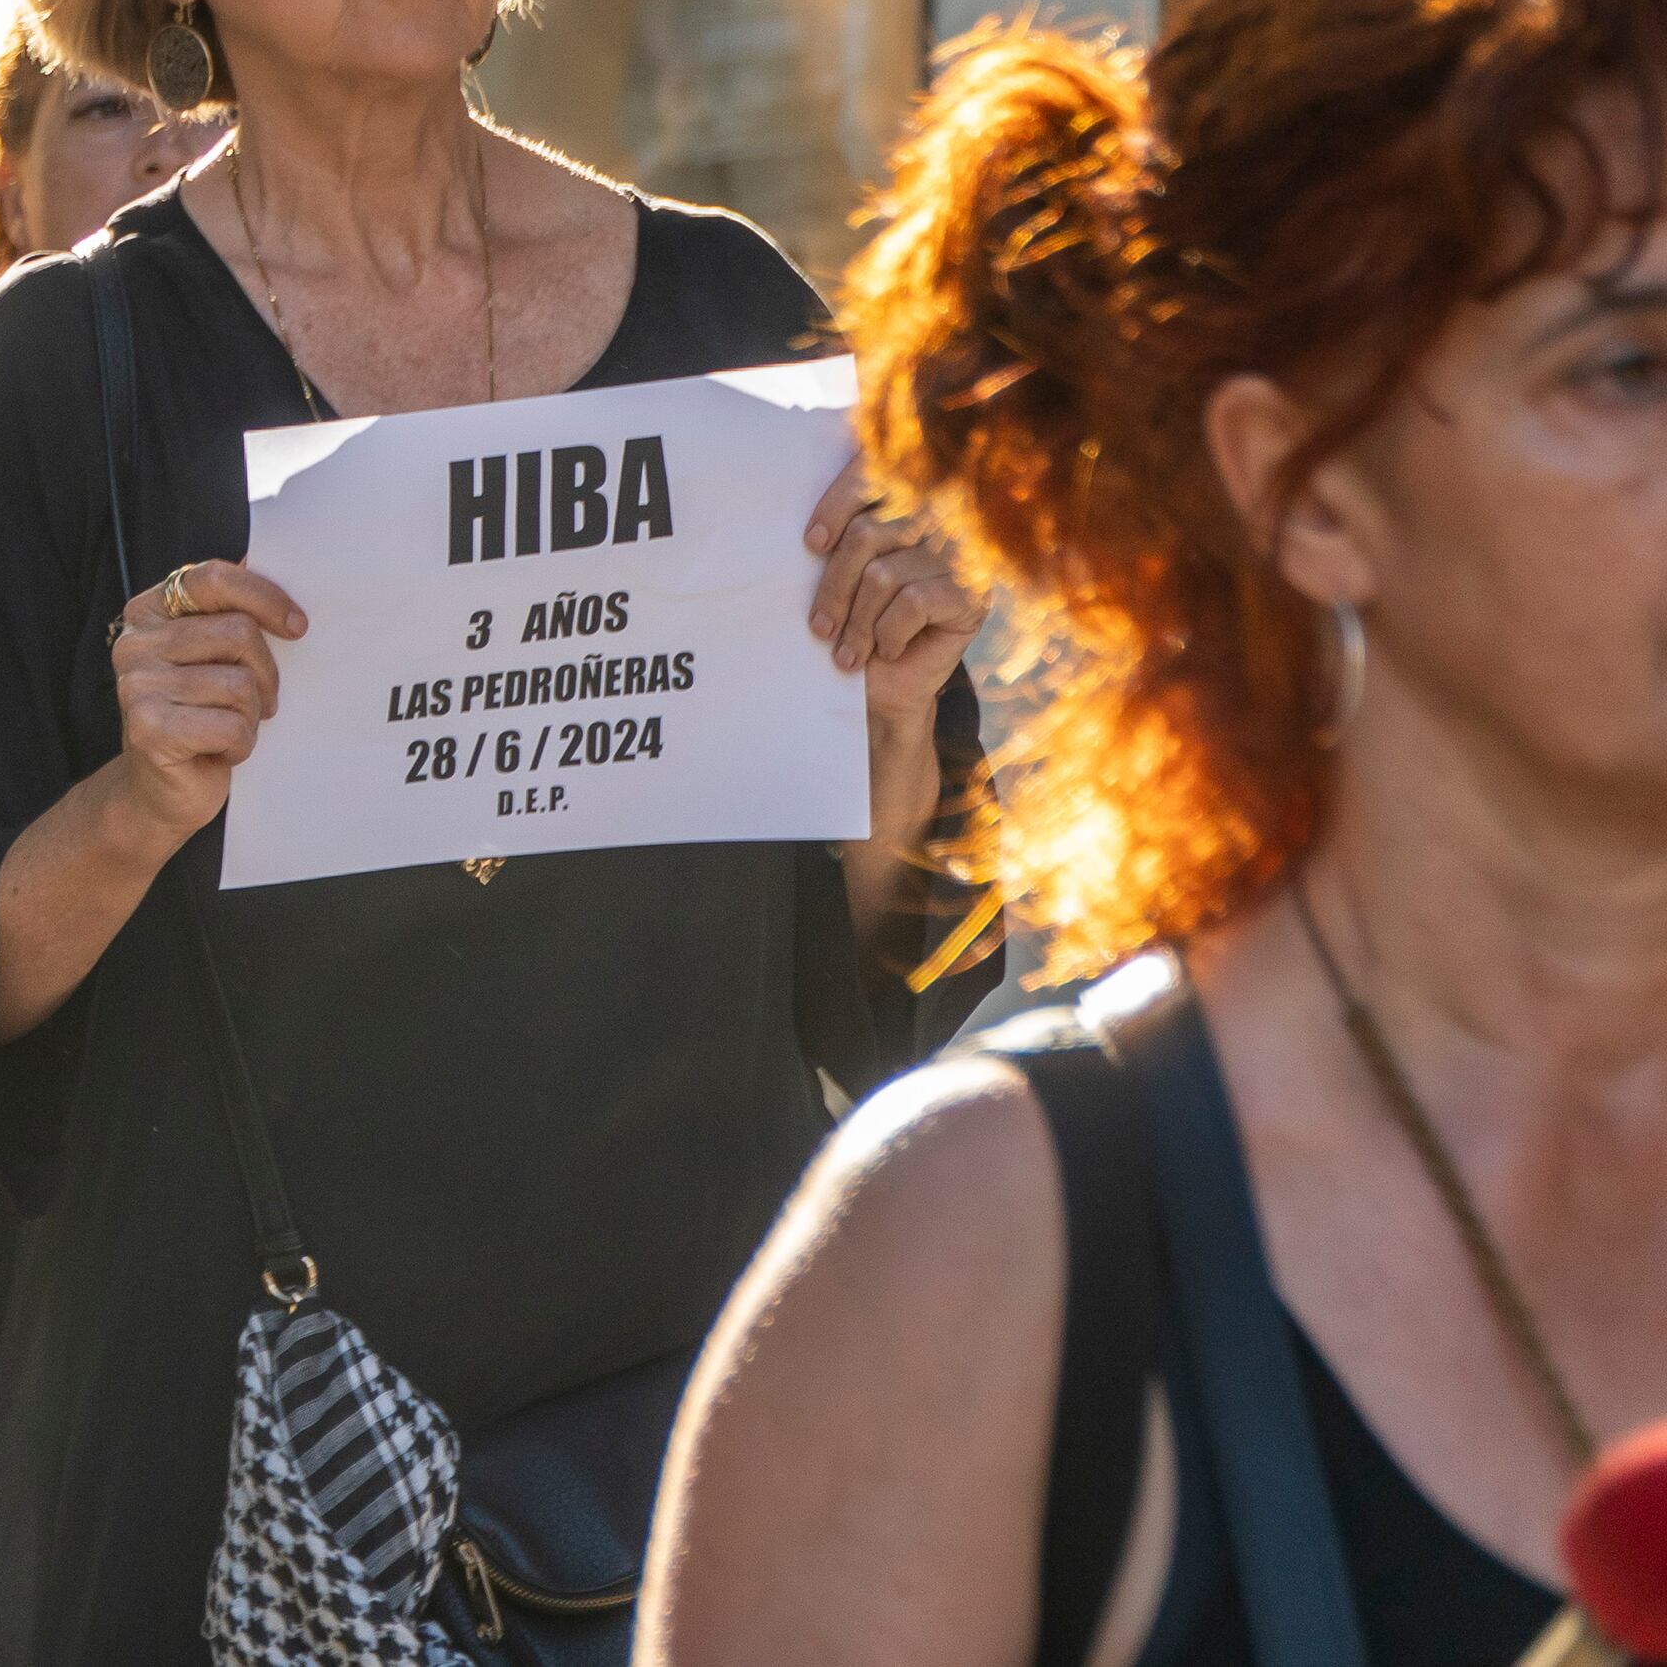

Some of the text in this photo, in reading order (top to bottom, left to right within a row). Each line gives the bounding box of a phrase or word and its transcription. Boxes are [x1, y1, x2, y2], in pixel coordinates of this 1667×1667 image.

[447, 435, 675, 567] HIBA
[466, 591, 630, 650] 3 AÑOS
[388, 652, 696, 723] LAS PEDROÑERAS
[497, 786, 570, 818] D.E.P.
